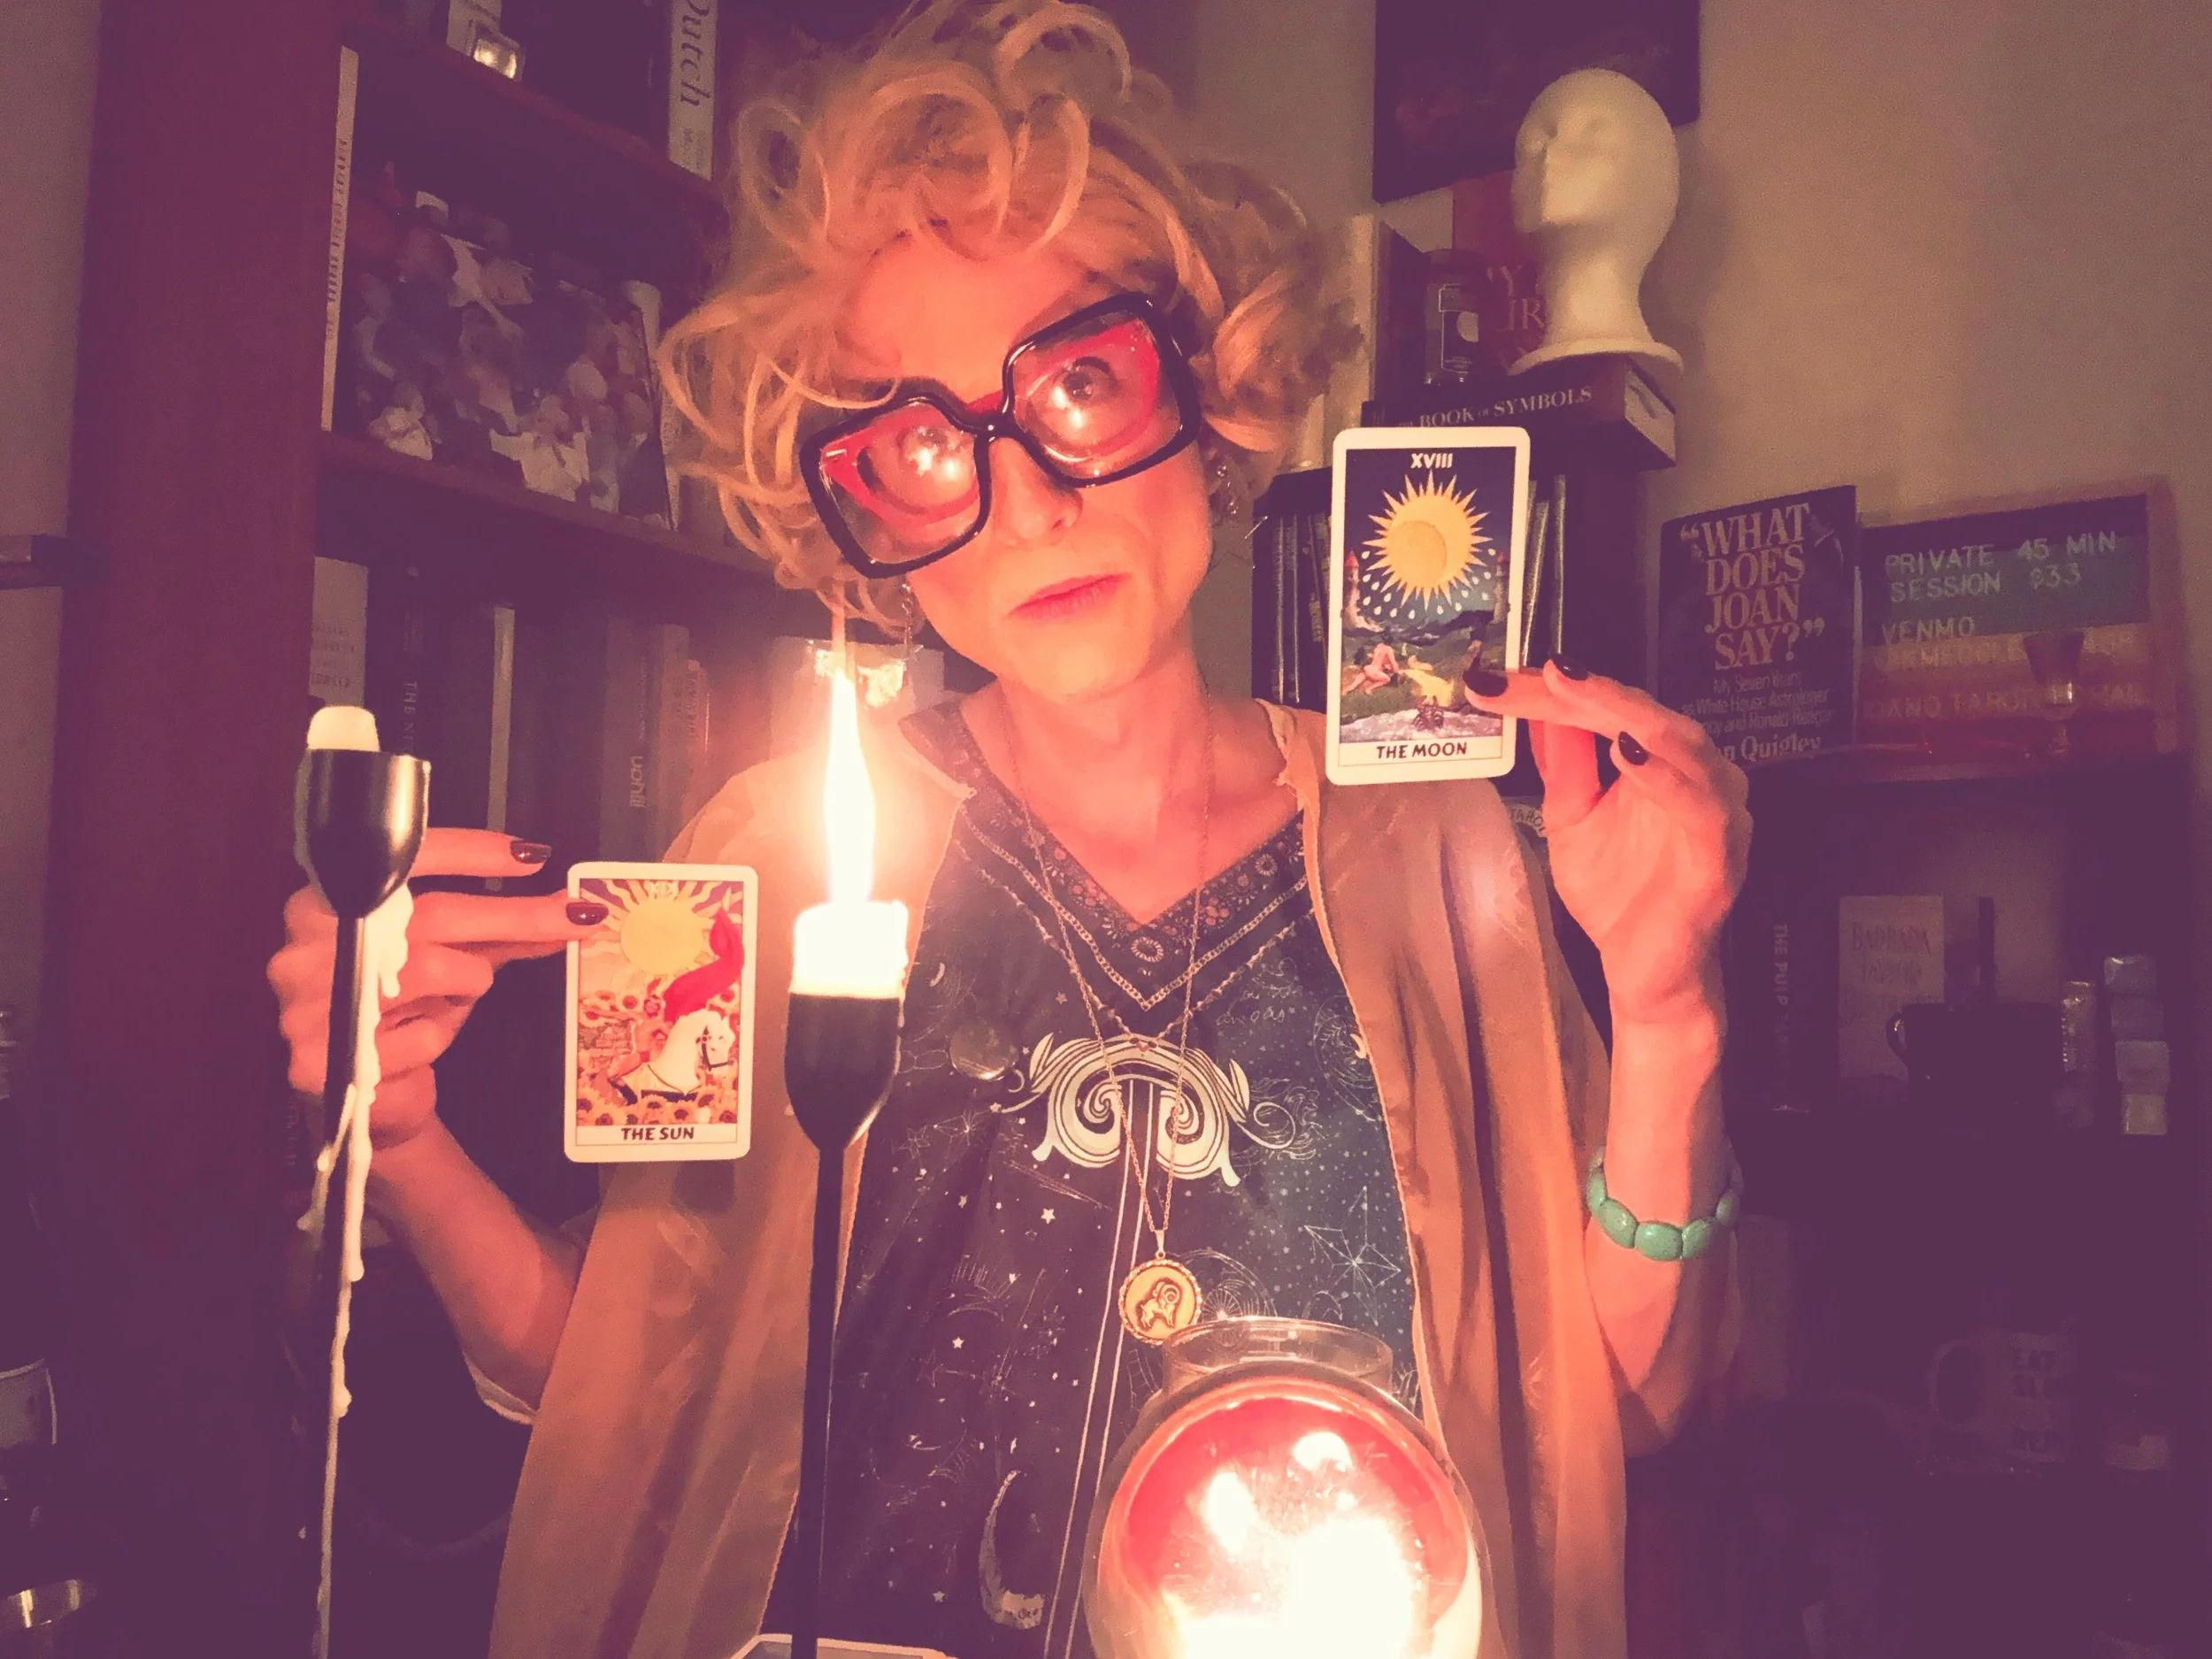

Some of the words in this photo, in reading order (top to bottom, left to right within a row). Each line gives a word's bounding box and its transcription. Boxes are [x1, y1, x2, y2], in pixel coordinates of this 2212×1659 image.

[1420, 407, 1475, 427] BOOK
[1493, 384, 1593, 418] SYMBOLS
[1410, 452, 1454, 469] XVIII
[1679, 503, 1810, 557] “WHAT
[1885, 543, 1995, 576] PRIVATE
[2017, 537, 2050, 561] 45
[2065, 531, 2116, 557] MIN
[1705, 543, 1806, 596] DOES
[1890, 571, 2001, 603] SESSION
[1704, 583, 1801, 634] JOAN
[1714, 617, 1825, 671] SAY?”
[1881, 616, 1976, 645] VENMO
[1735, 673, 1770, 692] Seven
[1772, 670, 1801, 687] Years
[1696, 697, 1728, 715] White
[1731, 694, 1767, 711] House
[1770, 687, 1831, 708] Astrologer
[1724, 711, 1747, 732] and
[1749, 709, 1790, 729] Ronald
[1377, 745, 1408, 759] THE
[1411, 741, 1467, 758] MOON
[1740, 733, 1822, 762] Quigley
[1773, 923, 1789, 956] THE
[621, 1127, 656, 1141] THE
[659, 1126, 695, 1141] SUN
